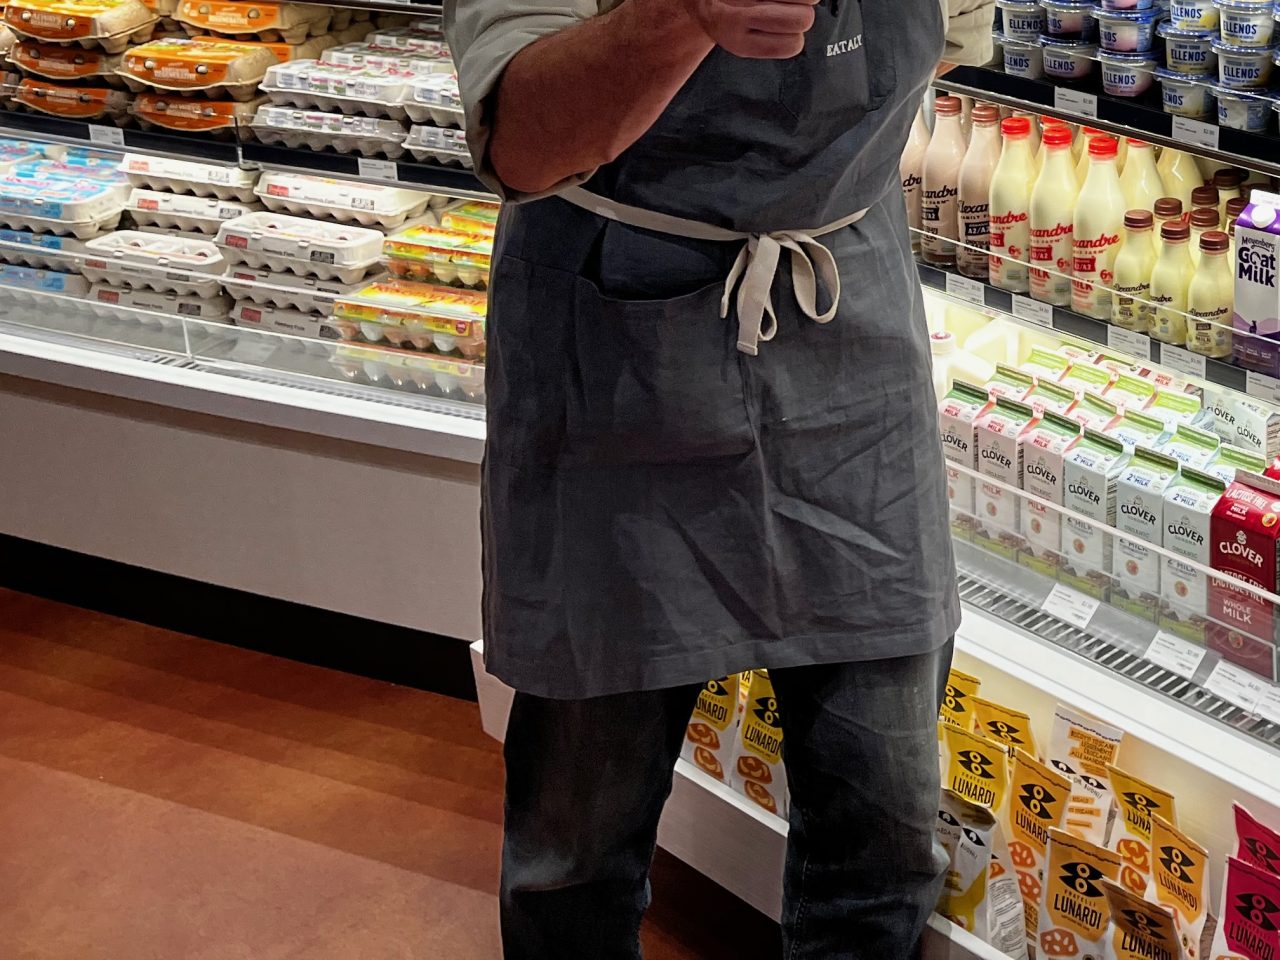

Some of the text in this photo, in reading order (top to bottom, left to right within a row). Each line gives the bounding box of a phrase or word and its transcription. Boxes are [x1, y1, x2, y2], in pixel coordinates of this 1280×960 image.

[1010, 18, 1043, 30] ELLENOS
[1223, 20, 1257, 35] ELLENOS
[826, 34, 862, 56] EATALY
[1104, 72, 1136, 85] ELLENOS
[1223, 65, 1259, 78] ELLENOS
[1242, 236, 1277, 252] Meyenberg
[1238, 247, 1276, 271] Goat
[1238, 262, 1275, 288] Milk
[982, 447, 1012, 470] CLOVER
[1068, 482, 1101, 505] CLOVER
[1120, 503, 1157, 526] CLOVER
[1167, 523, 1205, 546] CLOVER
[1219, 540, 1264, 569] CLOVER
[1222, 605, 1253, 625] MILK
[1223, 600, 1252, 615] WHOLE
[745, 723, 781, 756] LUNARDI
[952, 775, 996, 808] LUNARDI
[1016, 810, 1049, 848] LUNARD
[1158, 871, 1198, 913] LUNARDI
[1053, 892, 1103, 930] LUNARDI
[1229, 921, 1275, 960] LUNARDI
